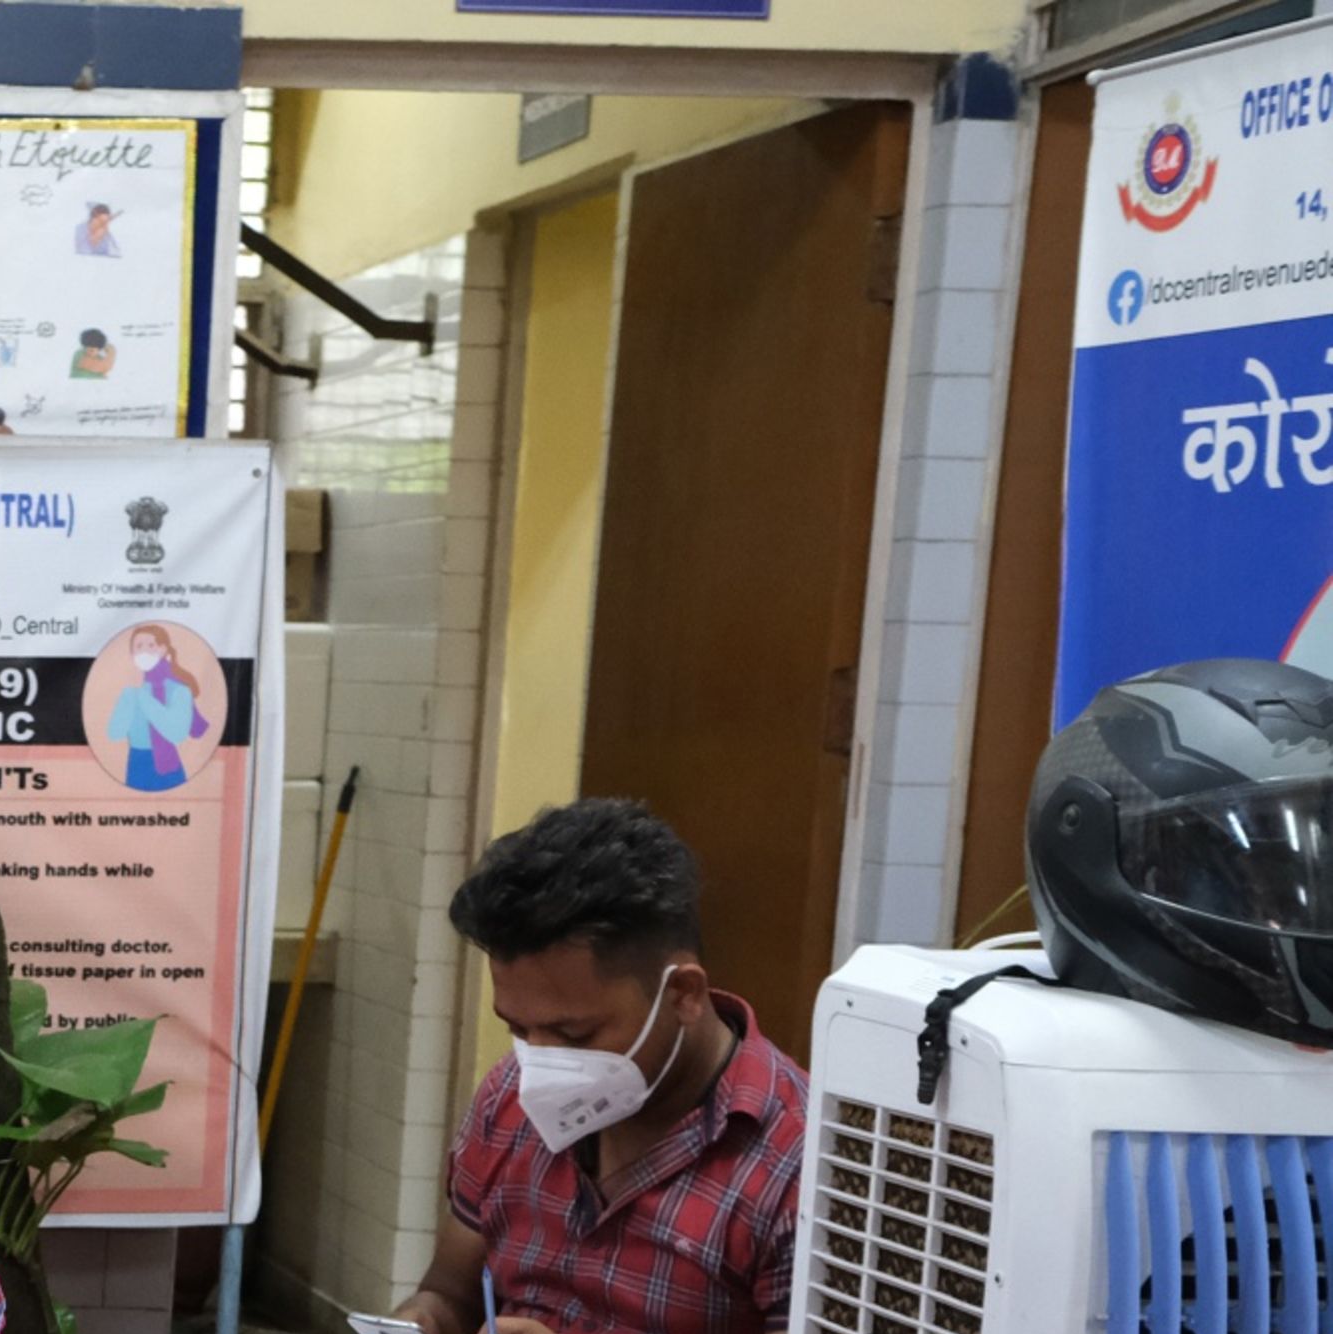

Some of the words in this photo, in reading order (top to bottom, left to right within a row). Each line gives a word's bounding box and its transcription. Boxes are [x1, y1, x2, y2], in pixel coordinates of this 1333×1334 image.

[1241, 77, 1312, 139] OFFICE
[1296, 188, 1328, 221] 14,
[62, 583, 99, 596] Ministry
[97, 598, 154, 609] Government
[53, 811, 92, 827] with
[98, 811, 190, 827] unwashed
[45, 863, 99, 878] hands
[104, 863, 154, 878] while
[9, 939, 105, 957] consulting
[111, 940, 173, 954] doctor.
[21, 964, 77, 978] tissue
[82, 966, 134, 981] paper
[140, 964, 156, 978] in
[162, 967, 205, 982] open
[58, 1014, 79, 1031] by
